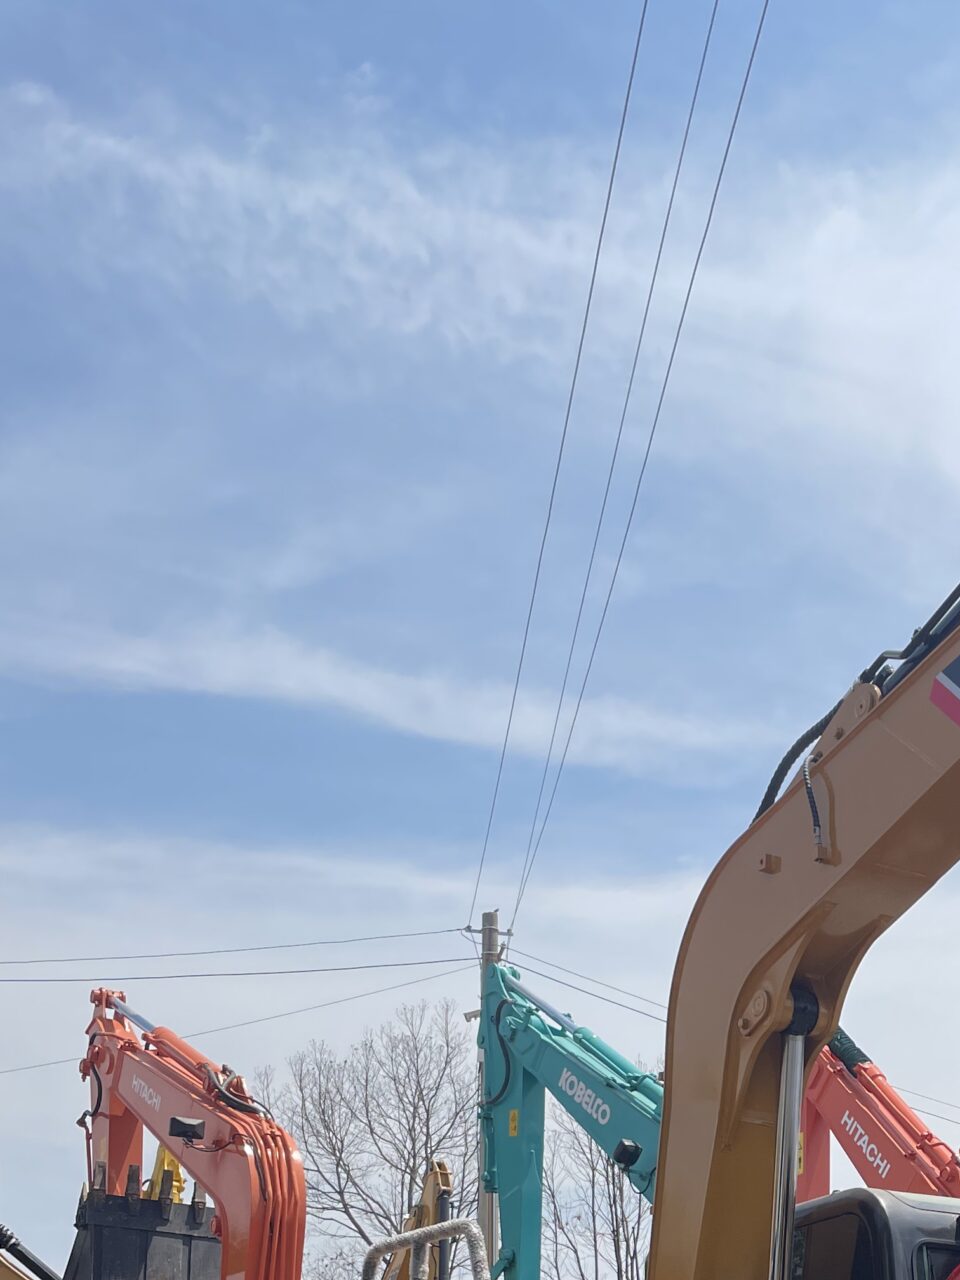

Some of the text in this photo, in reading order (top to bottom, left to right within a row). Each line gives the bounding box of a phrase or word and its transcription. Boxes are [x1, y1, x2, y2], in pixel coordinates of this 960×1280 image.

[131, 1073, 162, 1113] HITACHI
[558, 1067, 611, 1125] KOBELCO
[841, 1110, 891, 1179] HITACHI
